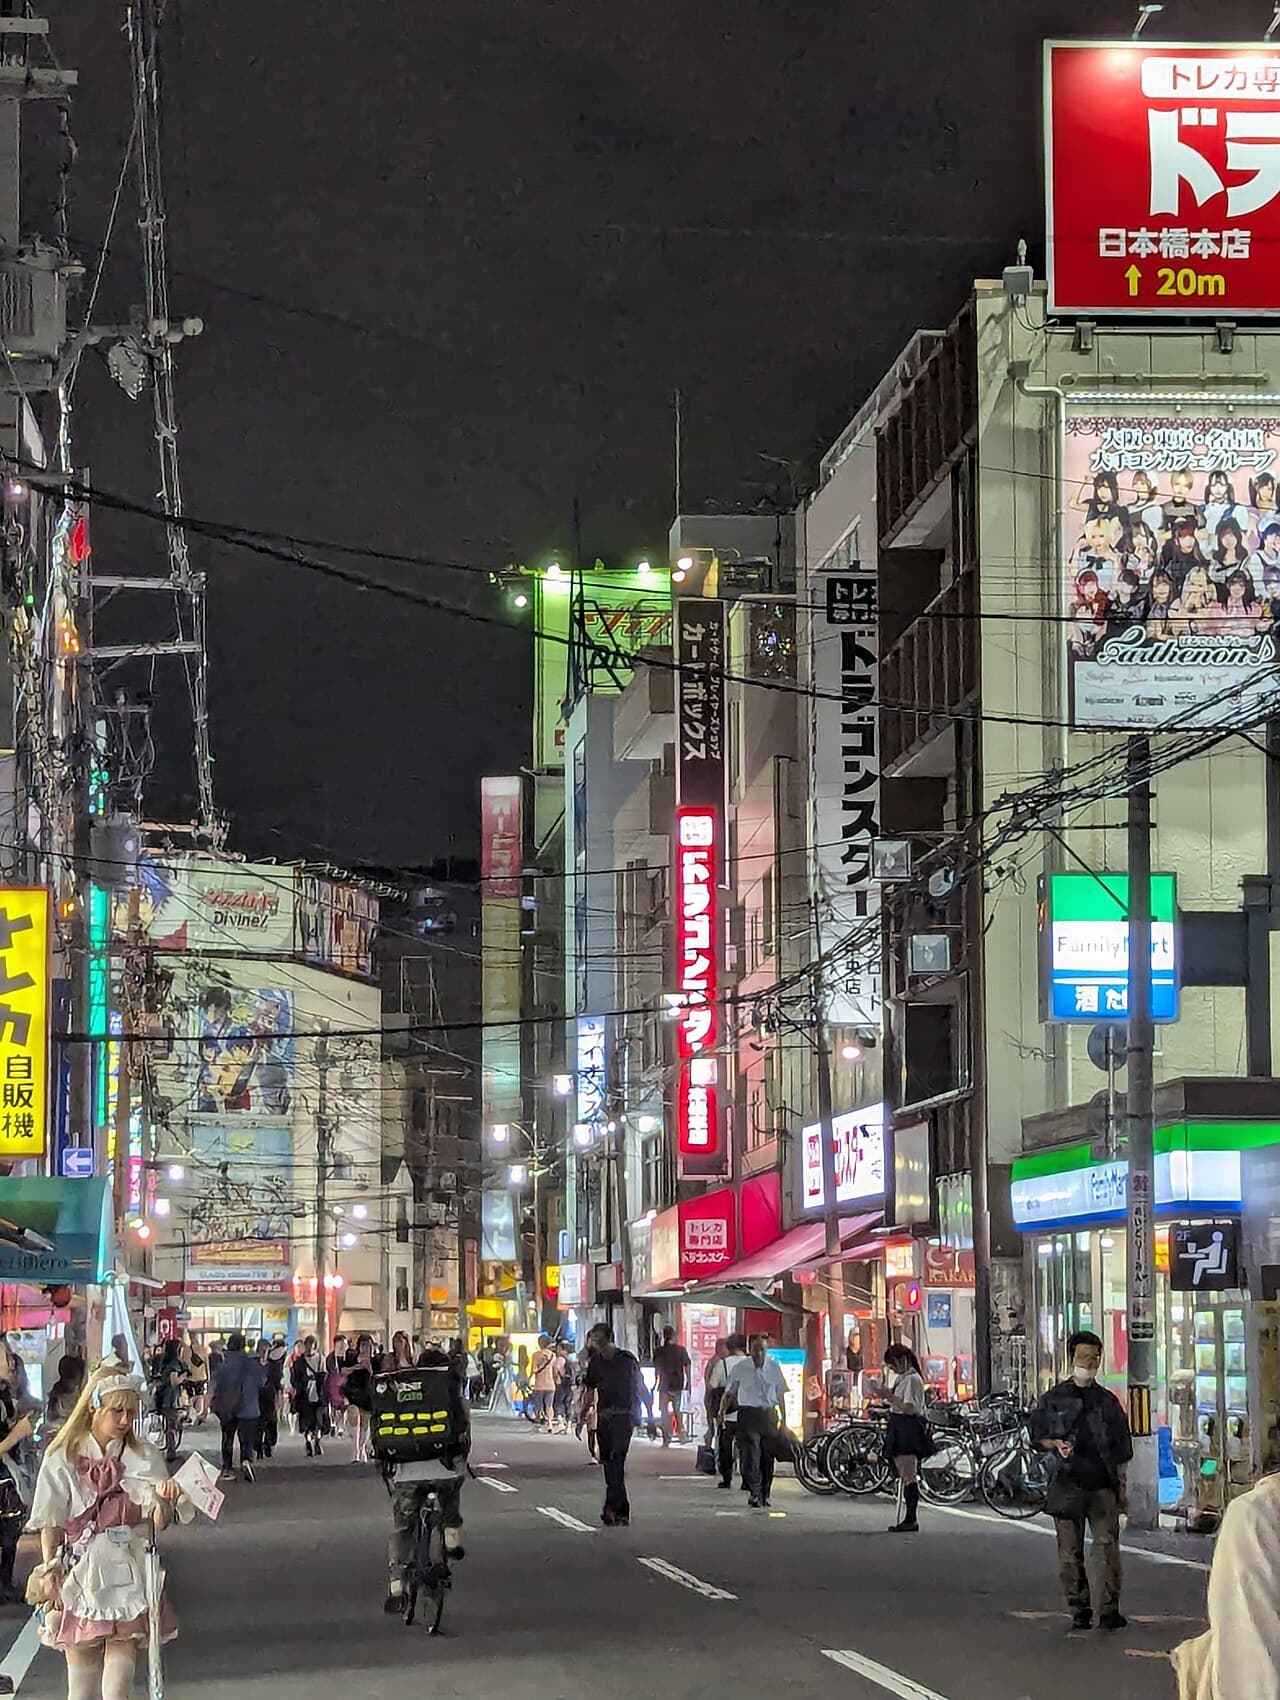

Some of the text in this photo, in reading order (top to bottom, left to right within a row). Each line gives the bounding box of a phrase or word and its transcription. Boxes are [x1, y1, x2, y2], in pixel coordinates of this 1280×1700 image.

[1172, 64, 1280, 92] トレカ専
[1148, 107, 1280, 218] ドラ
[1099, 227, 1251, 259] 日本橋本店
[1156, 267, 1225, 296] 20m
[1103, 428, 1263, 450] 大阪・東京・名古屋
[1091, 450, 1275, 472] 大手コンカフェグループ
[682, 623, 707, 761] カードボックス
[841, 631, 878, 916] ドラゴンスター
[1057, 936, 1168, 958] Familyrt
[1075, 985, 1128, 1012] 酒た
[2, 1054, 35, 1139] 自販機
[689, 1235, 723, 1246] 専門店
[690, 1222, 722, 1233] トレカ
[1176, 1230, 1192, 1242] 2F
